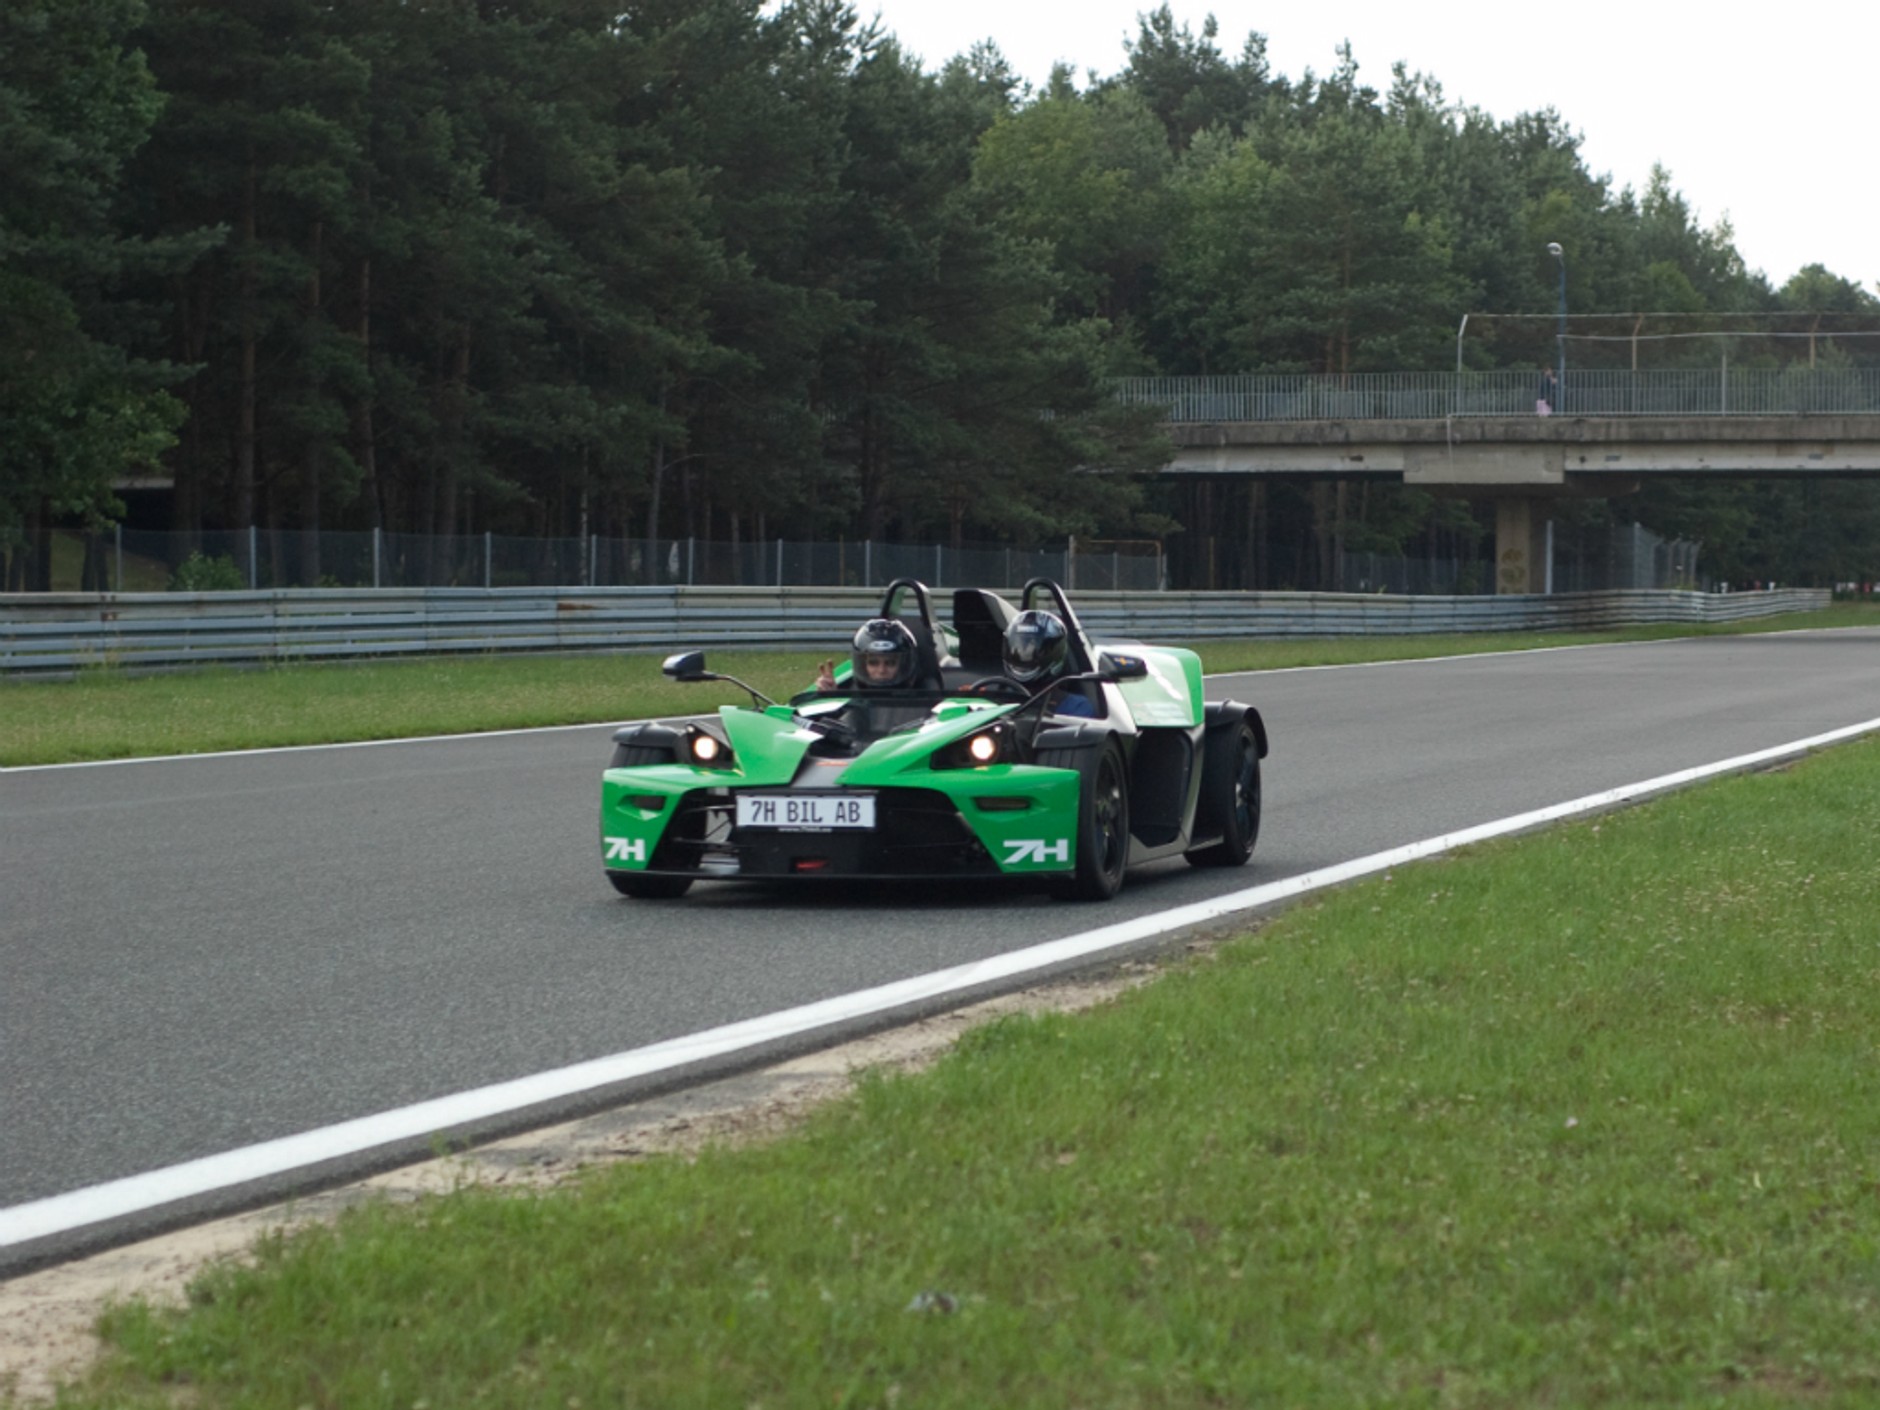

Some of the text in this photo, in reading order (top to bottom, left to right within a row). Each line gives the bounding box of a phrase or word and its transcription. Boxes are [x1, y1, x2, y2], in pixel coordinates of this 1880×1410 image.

[751, 800, 861, 823] 7H BIL AB
[604, 837, 646, 861] 7H
[1002, 838, 1068, 864] 7H
